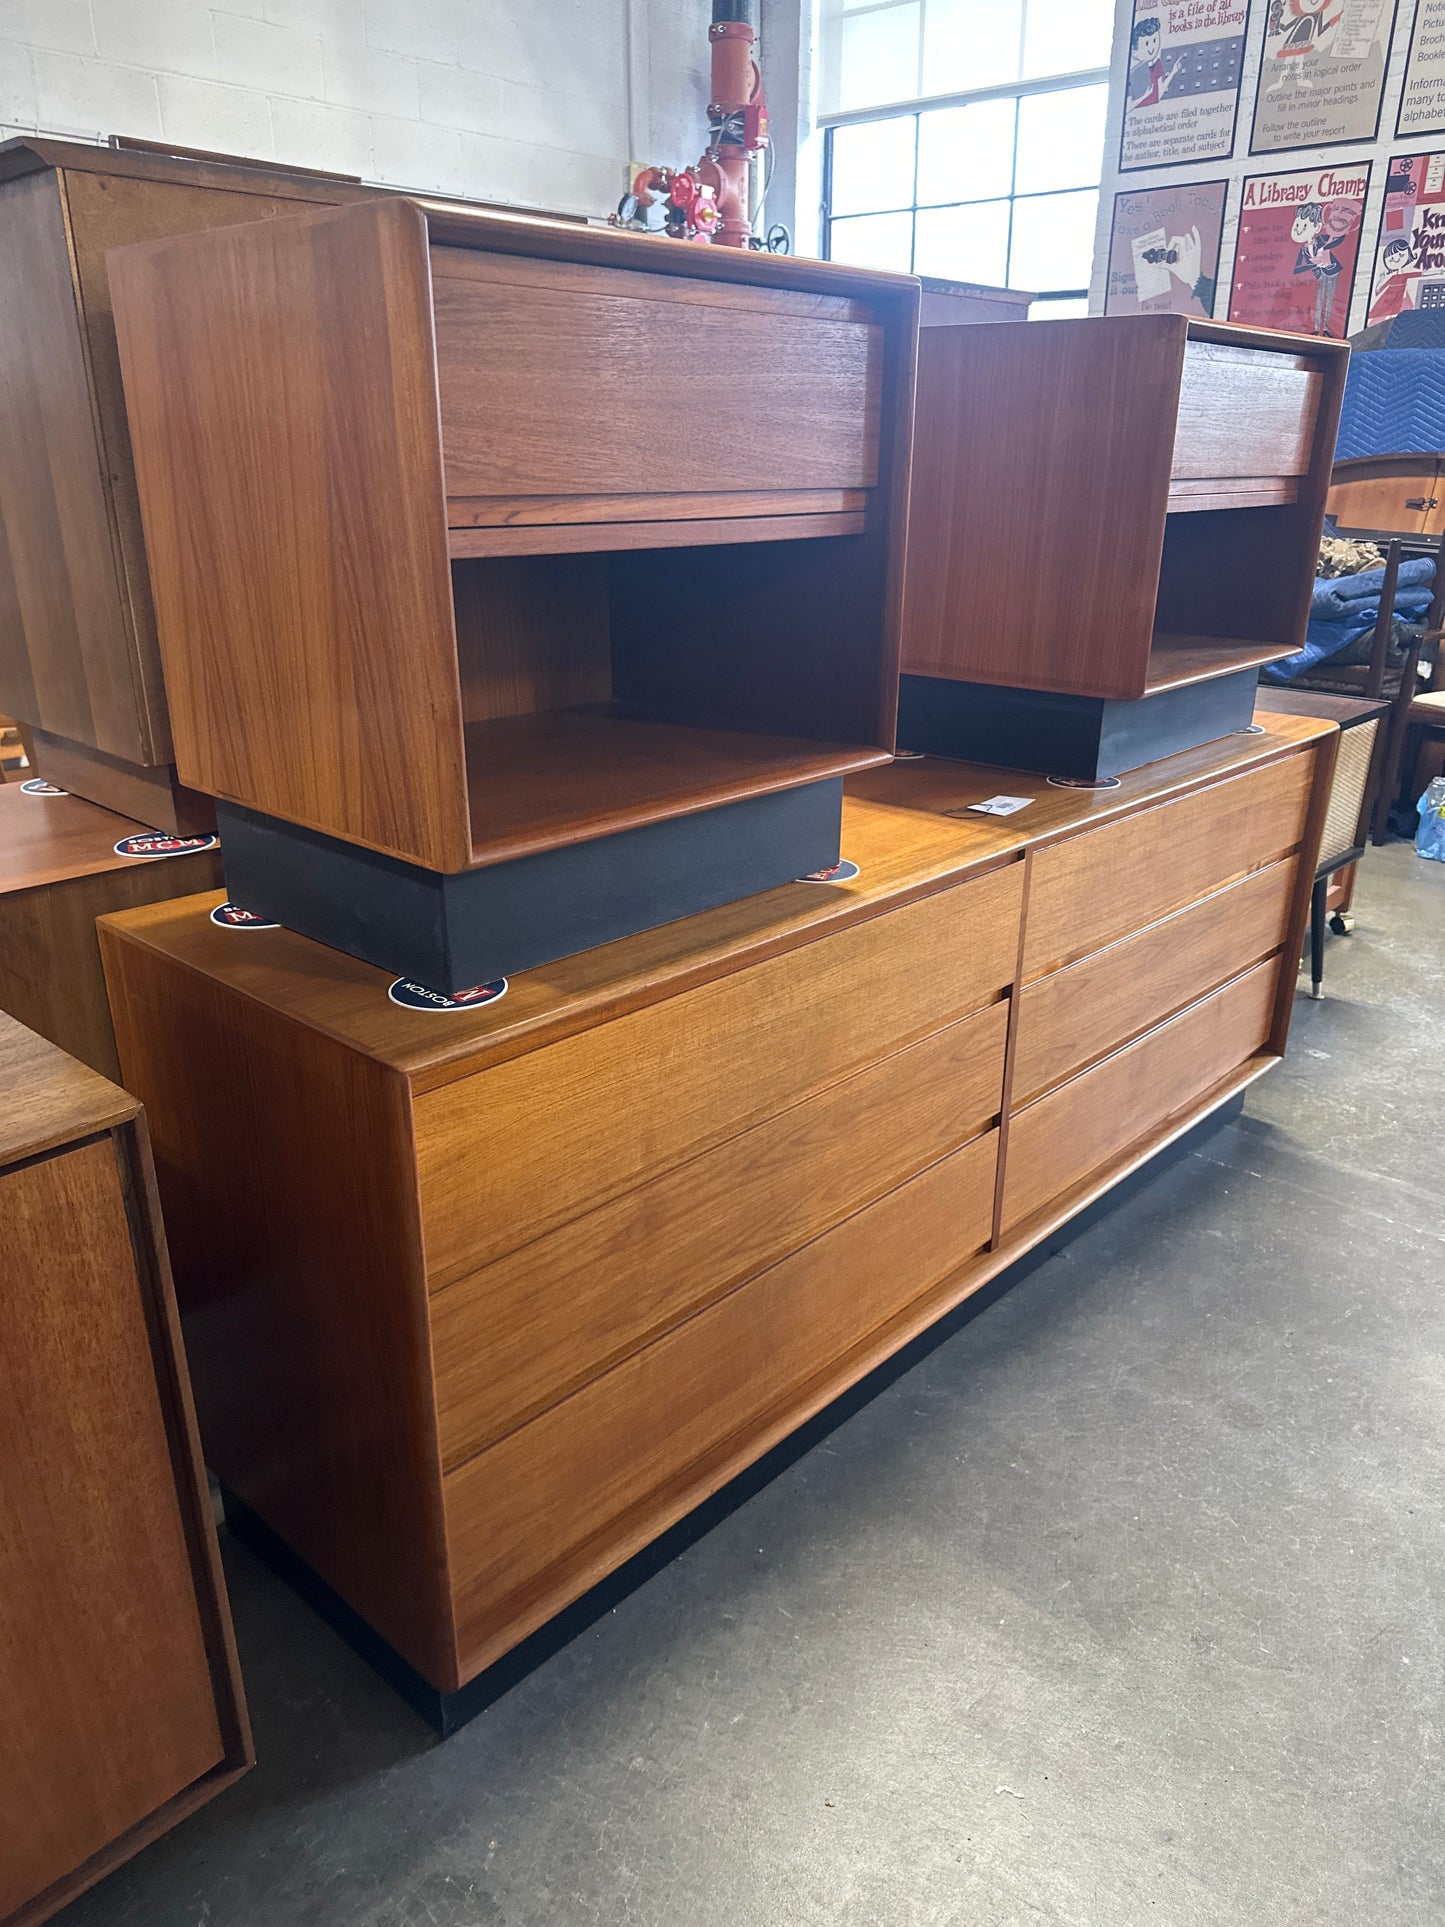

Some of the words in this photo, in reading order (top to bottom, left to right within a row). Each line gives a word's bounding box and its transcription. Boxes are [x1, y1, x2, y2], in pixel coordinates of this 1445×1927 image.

[1169, 9, 1177, 21] is
[1178, 10, 1185, 19] a
[1187, 2, 1205, 17] file
[1207, 0, 1217, 12] of
[1218, 0, 1232, 11] all
[1167, 19, 1193, 34] books
[1195, 17, 1203, 30] in
[1204, 14, 1217, 28] the
[1217, 10, 1246, 27] library
[1270, 61, 1301, 73] Arrange
[1302, 58, 1320, 70] your
[1281, 71, 1303, 83] notes
[1304, 69, 1312, 79] in
[1314, 66, 1339, 78] logical
[1340, 63, 1362, 73] order
[1266, 91, 1293, 103] Outline
[1294, 89, 1307, 99] the
[1309, 85, 1332, 97] major
[1333, 82, 1358, 94] points
[1360, 79, 1376, 90] and
[1406, 94, 1435, 106] many
[1277, 103, 1287, 113] fill
[1288, 103, 1296, 112] in
[1297, 99, 1321, 110] minor
[1322, 93, 1359, 106] headings
[1128, 117, 1143, 126] The
[1144, 113, 1165, 124] cards
[1166, 112, 1179, 121] are
[1180, 107, 1198, 118] filed
[1199, 103, 1234, 116] together
[1131, 122, 1177, 138] alphabetical
[1177, 119, 1198, 130] order
[1262, 122, 1284, 133] Follow
[1286, 120, 1299, 131] the
[1301, 117, 1327, 128] outline
[1273, 133, 1282, 142] to
[1283, 130, 1301, 141] write
[1302, 128, 1320, 141] your
[1321, 125, 1346, 138] report
[1126, 140, 1149, 151] There
[1149, 139, 1162, 148] are
[1163, 134, 1195, 146] separate
[1196, 129, 1217, 140] cards
[1219, 128, 1232, 138] for
[1181, 143, 1196, 154] and
[1198, 139, 1225, 153] subject
[1244, 182, 1256, 206] A
[1258, 181, 1313, 205] Library
[1317, 172, 1367, 198] Champ
[1120, 198, 1142, 215] Yes
[1152, 197, 1183, 223] Book
[1110, 284, 1118, 297] it
[128, 839, 200, 853] MCM
[401, 982, 456, 1007] BOSTON
